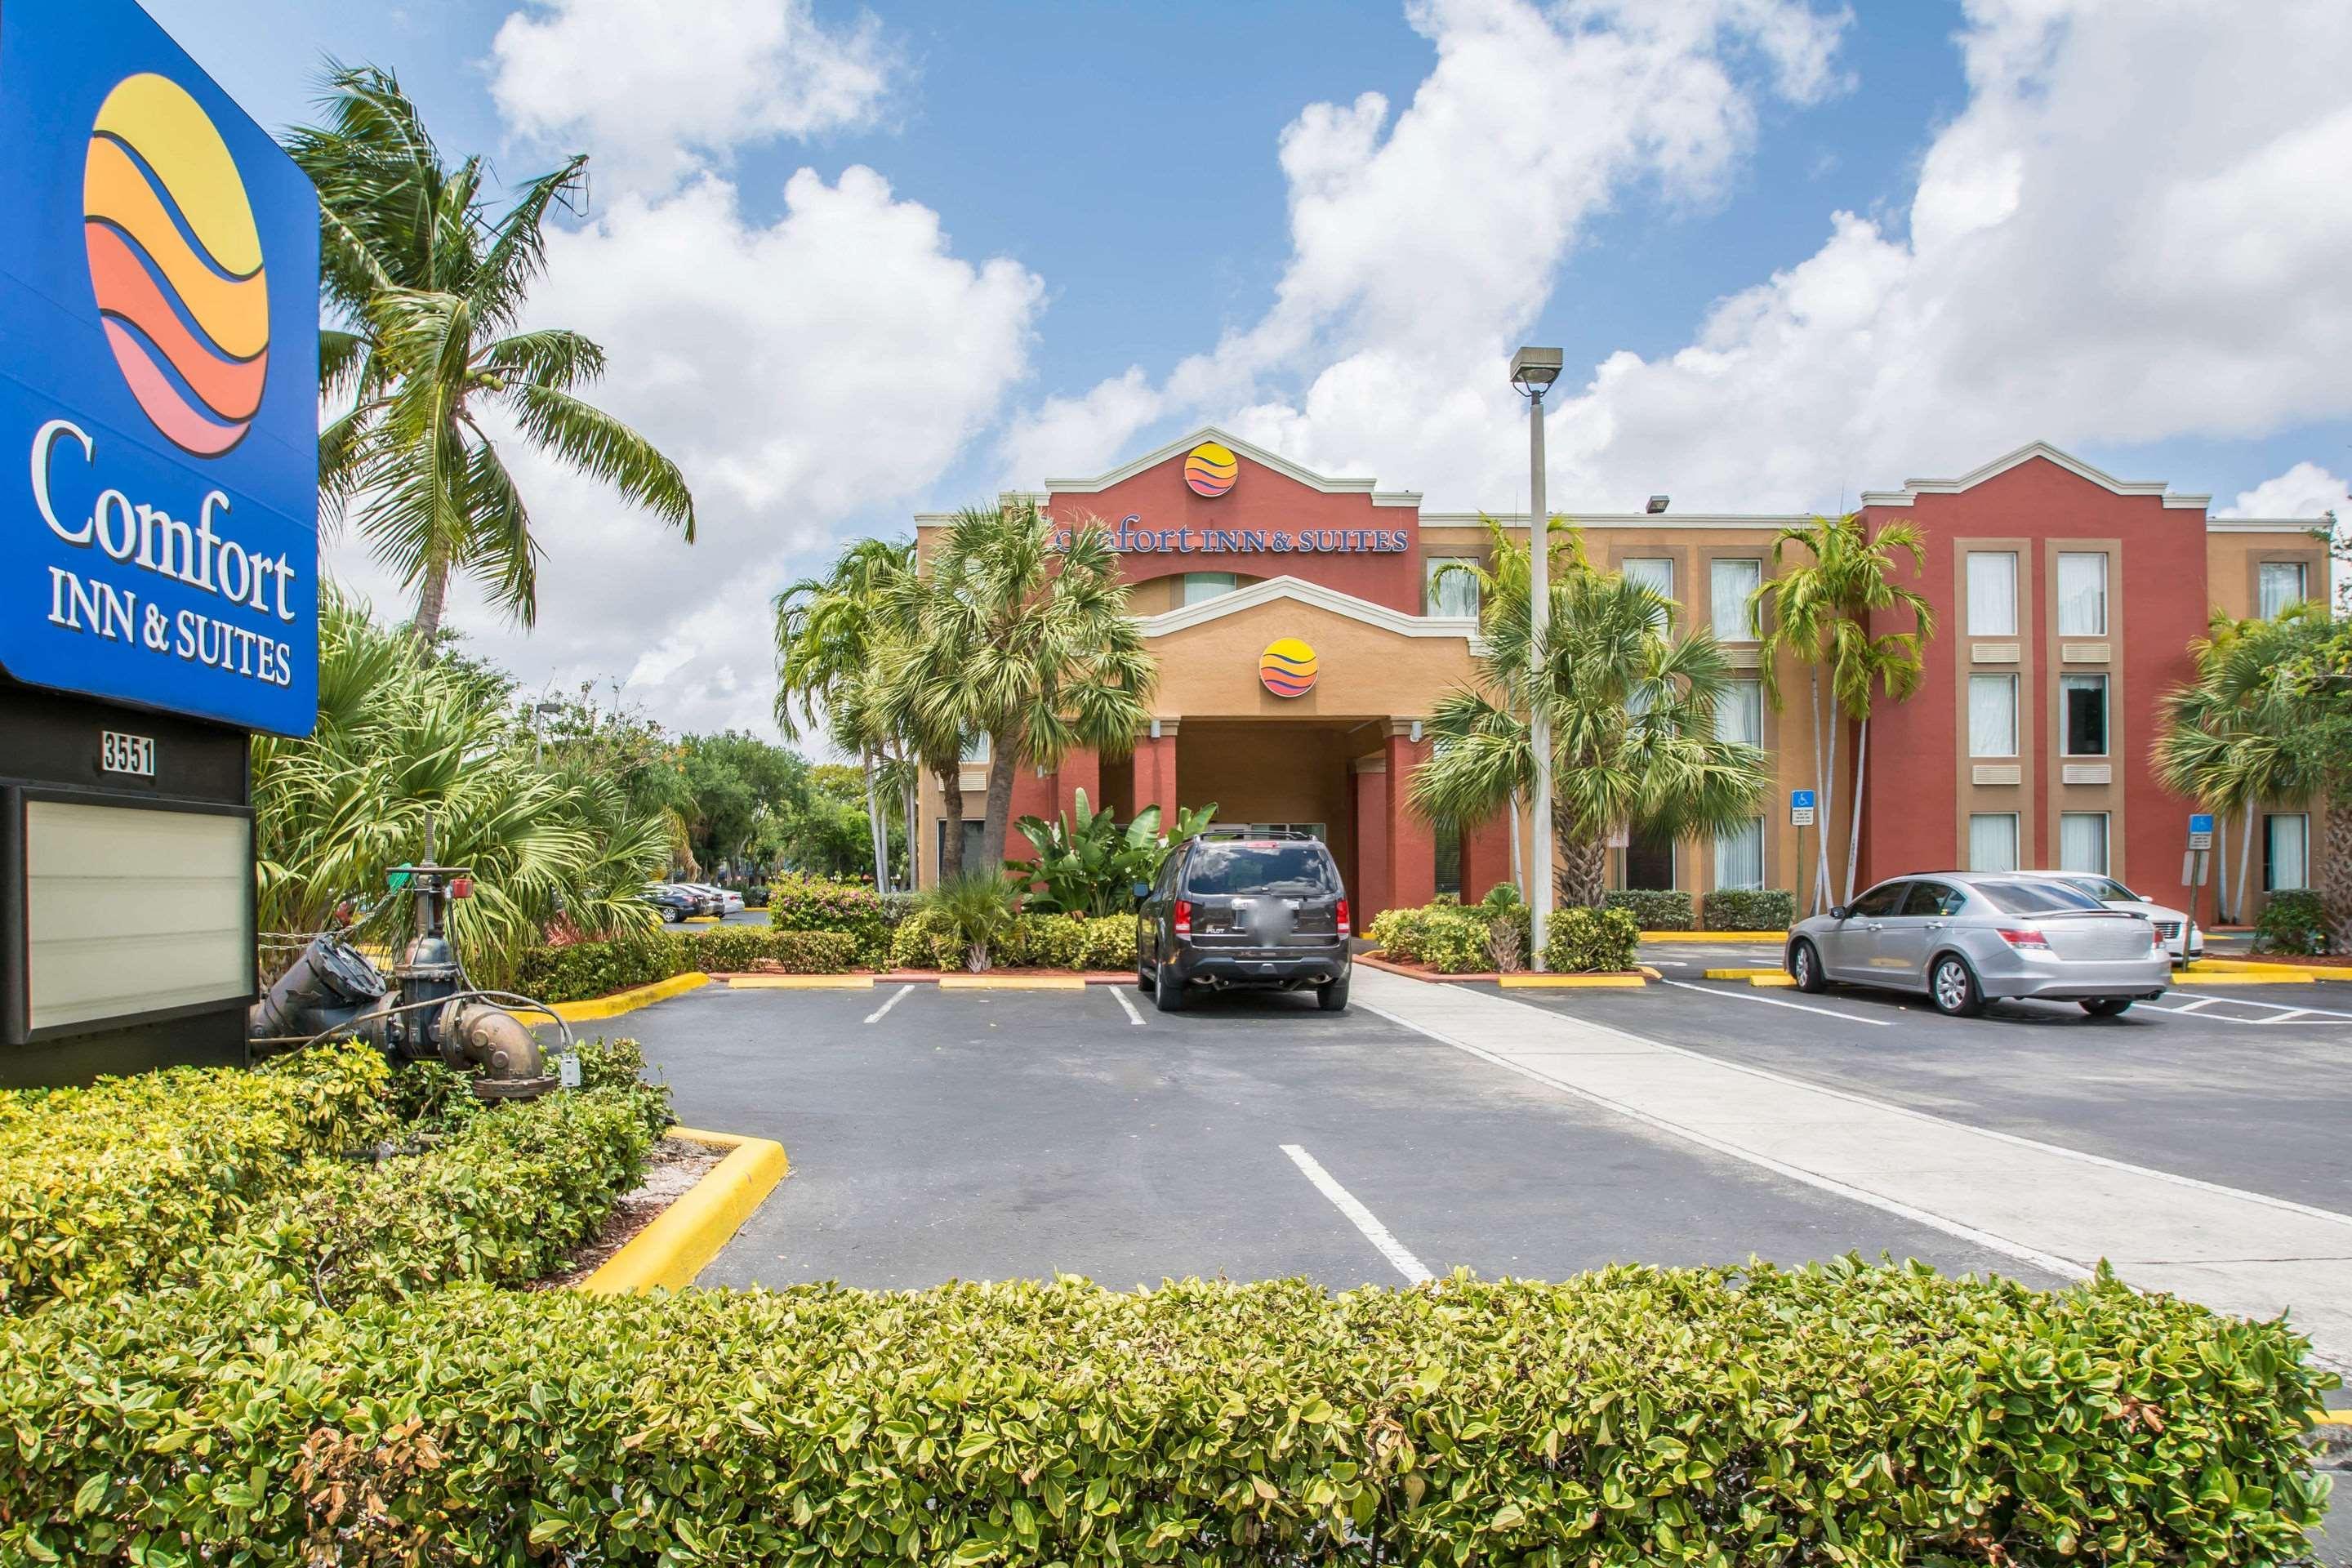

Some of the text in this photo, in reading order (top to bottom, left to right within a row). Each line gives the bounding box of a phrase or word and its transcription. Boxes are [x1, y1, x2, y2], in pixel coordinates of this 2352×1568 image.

[31, 419, 295, 621] Comfort
[1042, 514, 1409, 553] ofort INN & SUITES
[48, 566, 291, 687] INN & SUITES
[105, 733, 152, 773] 3551
